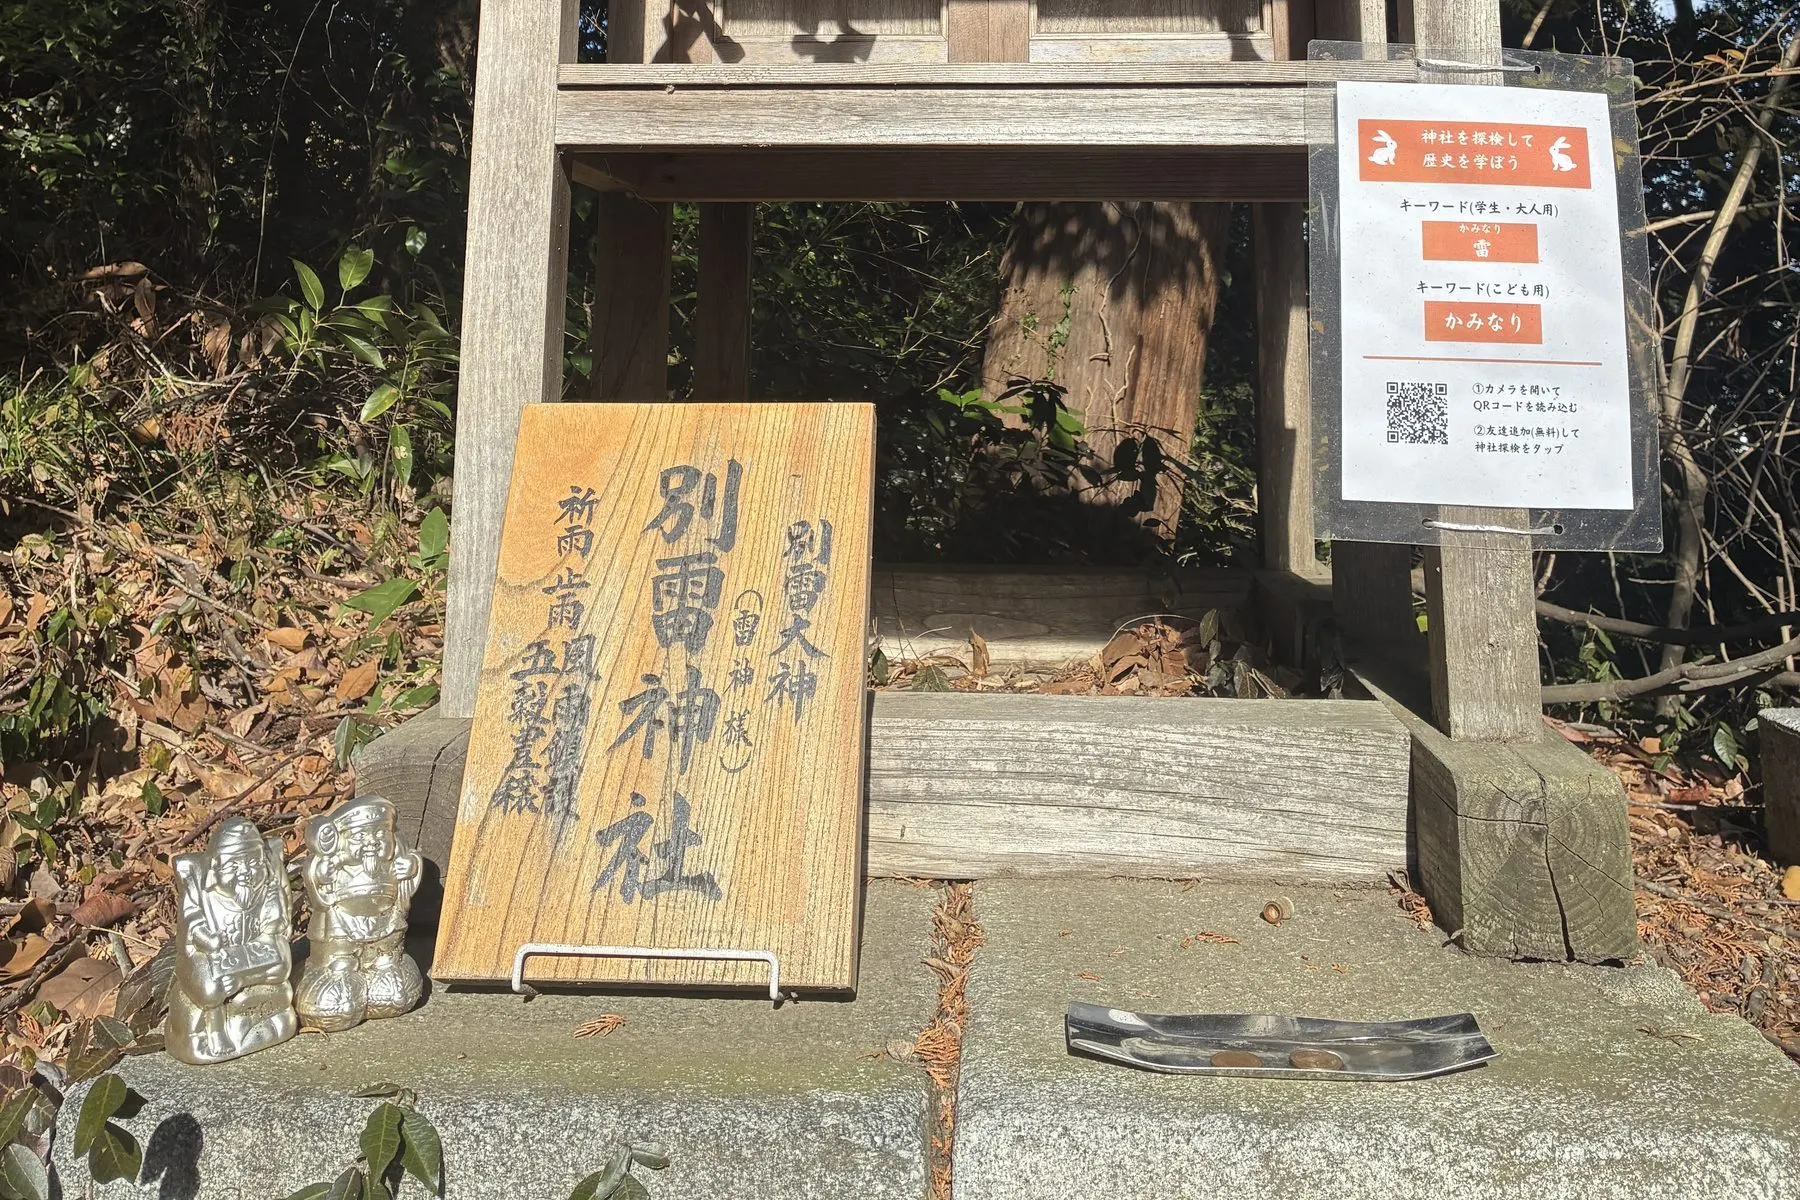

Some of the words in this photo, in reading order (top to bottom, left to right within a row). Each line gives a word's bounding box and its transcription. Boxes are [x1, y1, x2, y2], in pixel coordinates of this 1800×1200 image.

[1420, 129, 1535, 148] 神社を探検して
[1422, 153, 1519, 171] 歴史を学ぼう
[1399, 198, 1559, 218] キーワード(学生・大人用)
[1458, 223, 1502, 235] かみなり
[1472, 239, 1492, 258] 雷
[1416, 280, 1550, 299] キーワード(こども用)
[1444, 312, 1522, 333] かみなり
[1472, 382, 1561, 397] ①カメラを開いて
[1473, 400, 1578, 413] QRコードを読み込む
[1473, 424, 1581, 440] ②友達追加(無料)して
[1474, 441, 1565, 455] 神社探検をタップ
[764, 518, 833, 727] 別雷大神
[592, 458, 743, 904] 別雷神社
